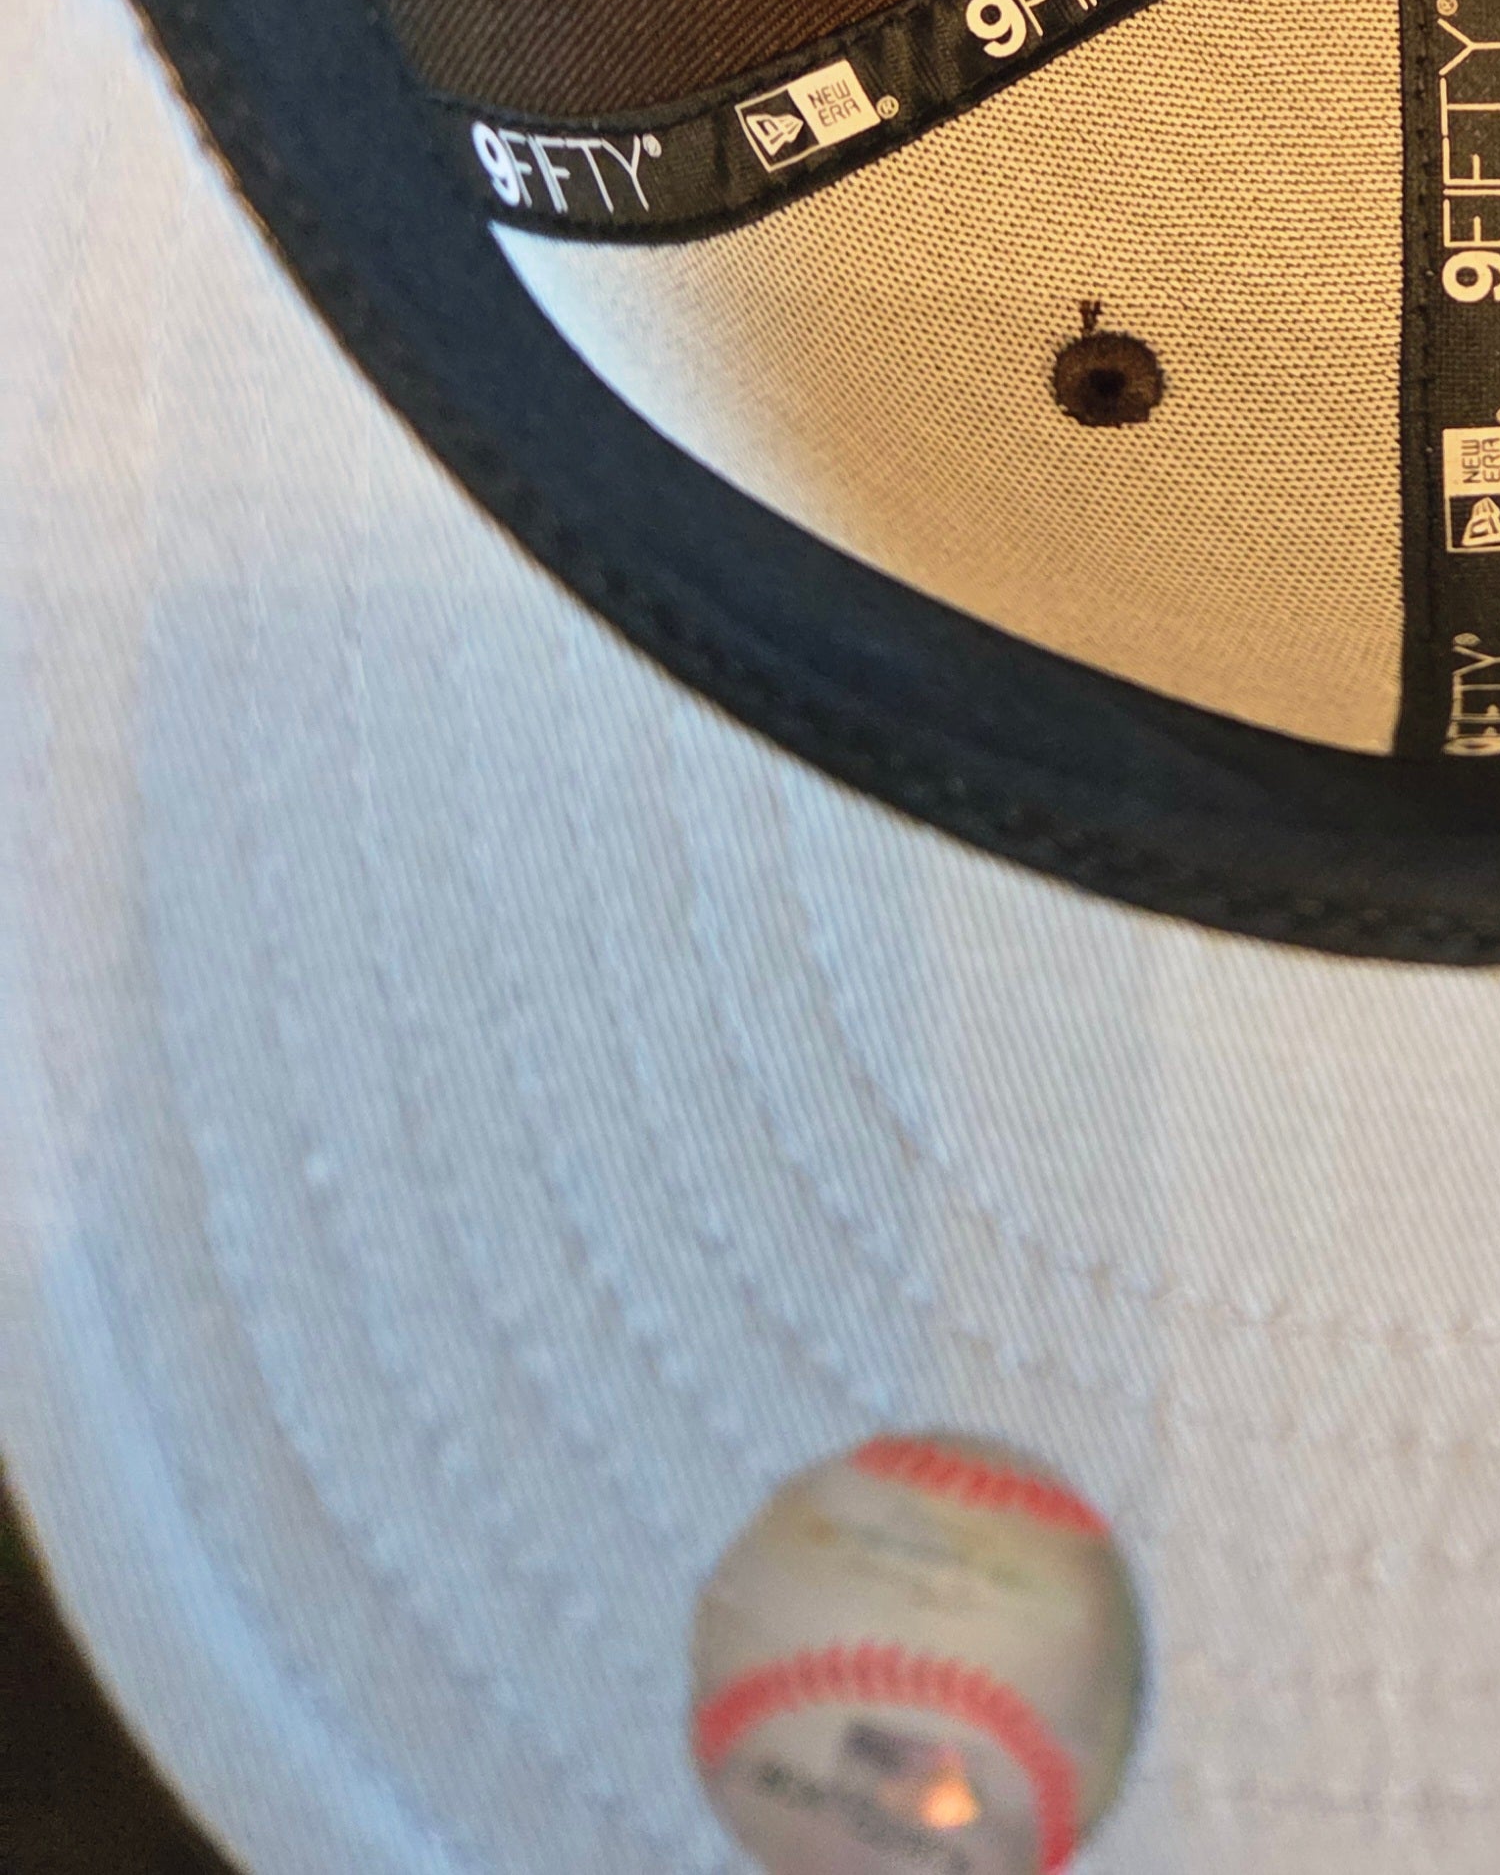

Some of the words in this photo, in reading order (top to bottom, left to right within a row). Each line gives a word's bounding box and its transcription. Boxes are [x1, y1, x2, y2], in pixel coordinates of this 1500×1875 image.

[807, 79, 851, 109] NEW
[818, 97, 862, 127] ERA
[1461, 439, 1481, 484] NEW
